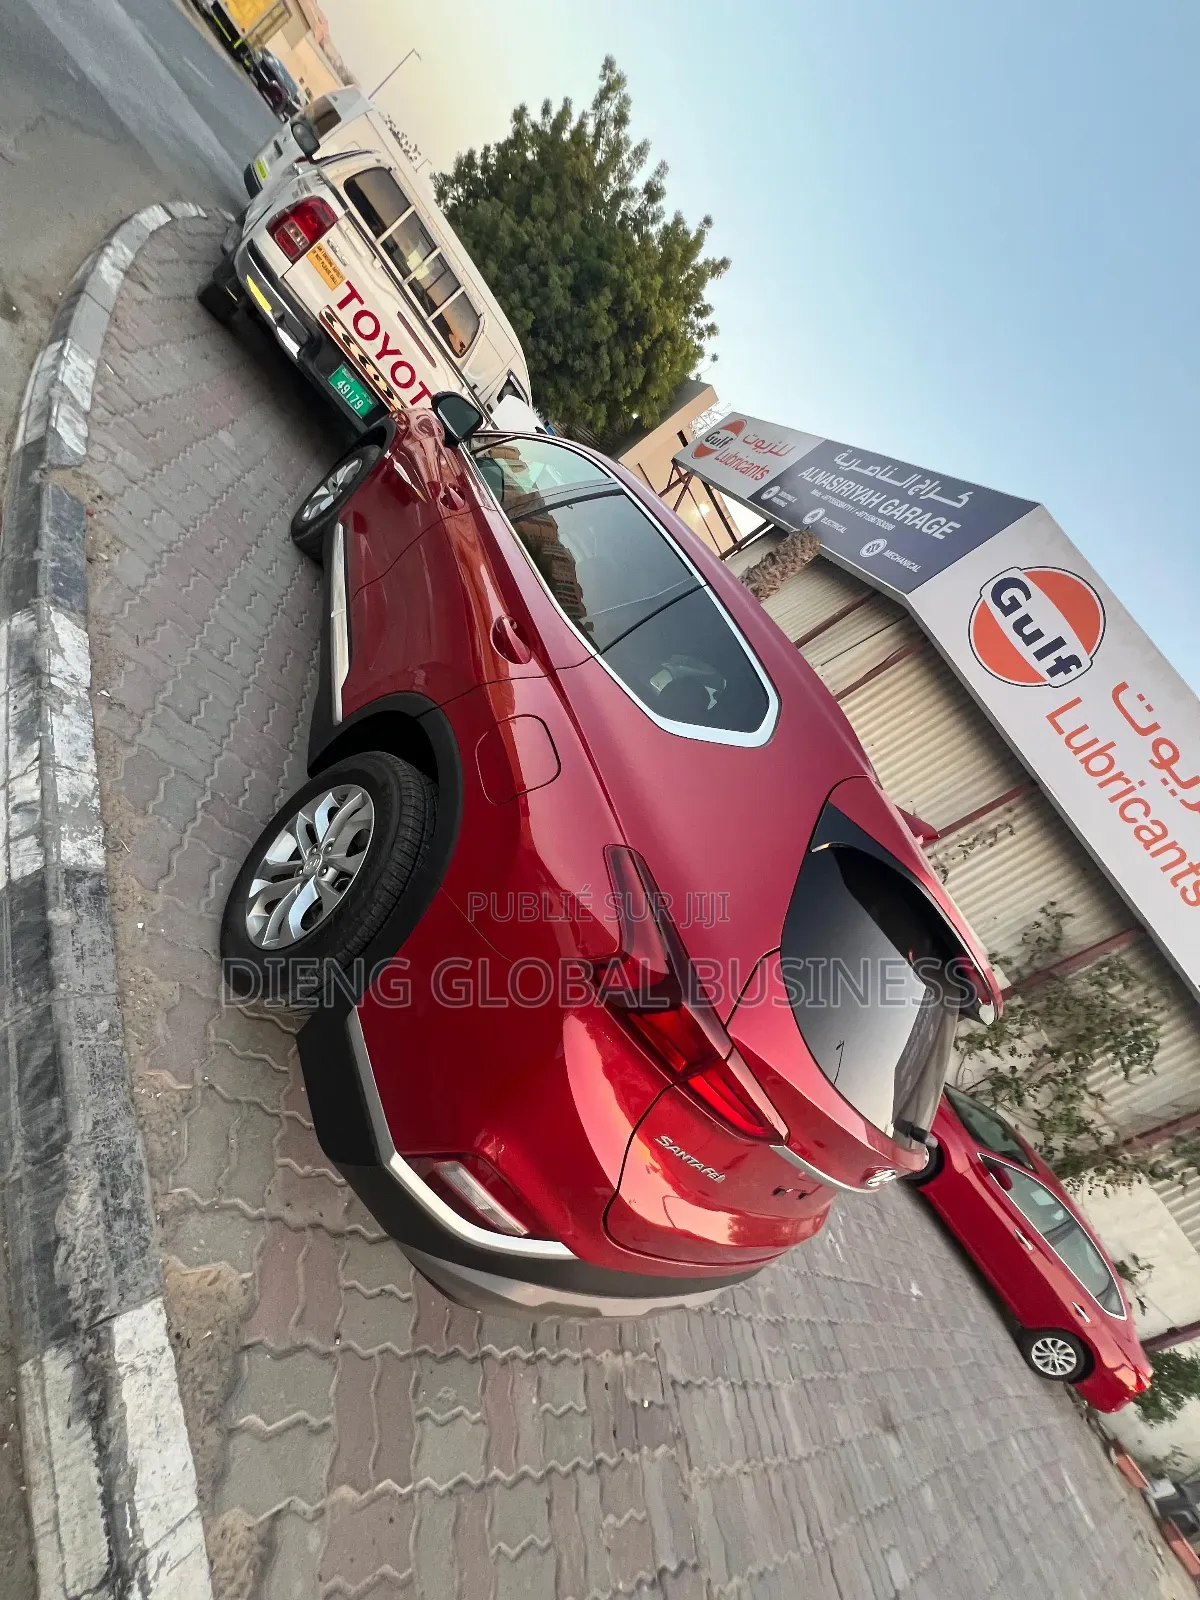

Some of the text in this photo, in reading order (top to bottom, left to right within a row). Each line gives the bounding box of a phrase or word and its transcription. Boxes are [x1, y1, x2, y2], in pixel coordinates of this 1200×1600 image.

[336, 280, 435, 410] TOYOT
[337, 380, 364, 410] 49179
[704, 430, 734, 449] Gulf
[742, 433, 796, 457] للزيوت
[714, 446, 770, 481] Lubricants
[833, 449, 922, 492] الناصرية
[797, 466, 962, 540] ALNASIRIYAH GARAGE
[820, 516, 848, 534] ELECTRICAL
[883, 549, 922, 573] MECHANICAL
[990, 576, 1084, 679] Gulf
[1045, 696, 1200, 908] Lubricants
